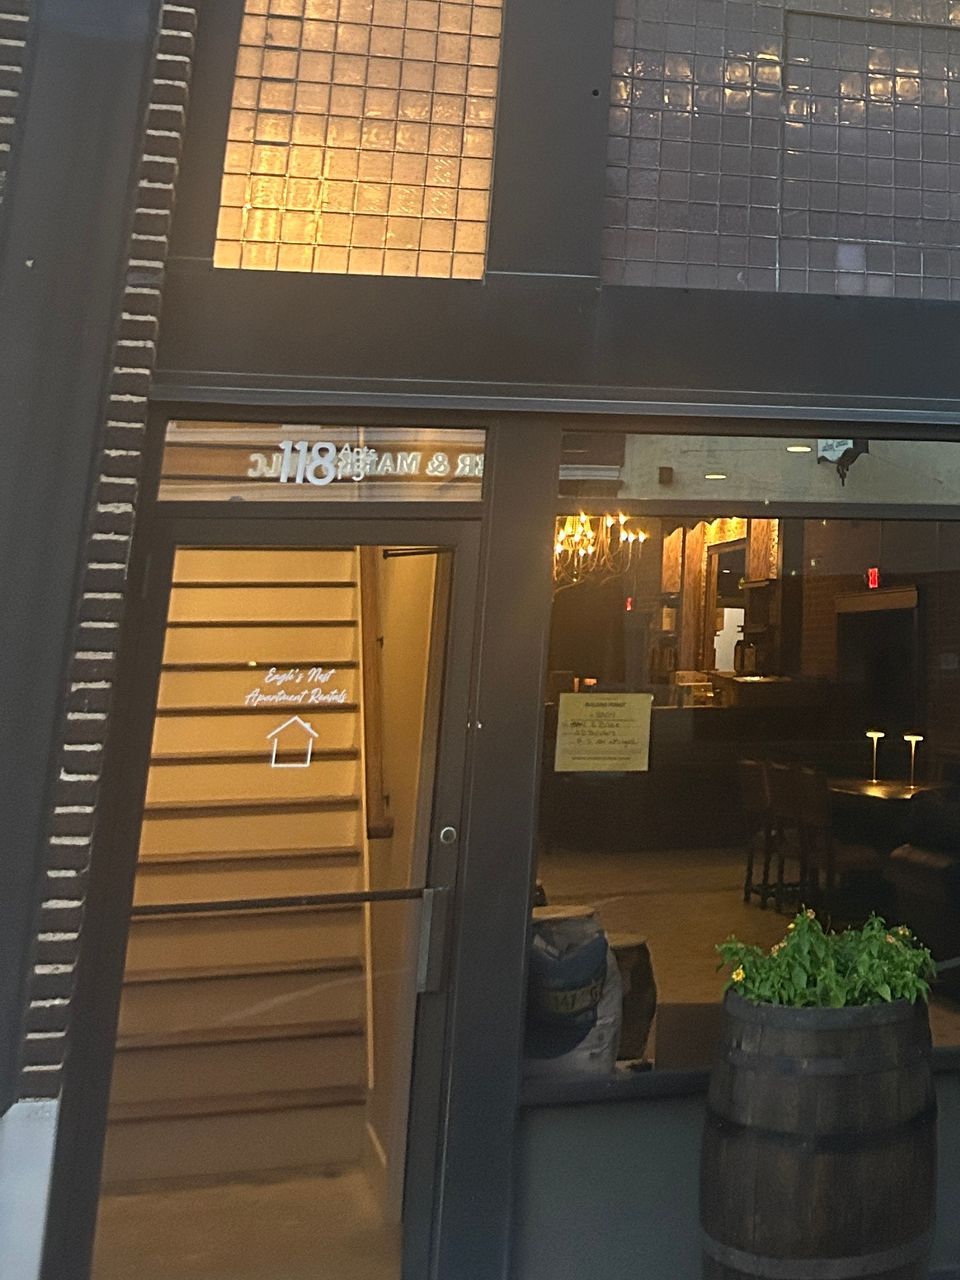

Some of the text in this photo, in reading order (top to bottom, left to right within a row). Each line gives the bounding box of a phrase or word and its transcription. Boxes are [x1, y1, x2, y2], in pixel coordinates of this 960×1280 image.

[278, 440, 337, 485] 118
[245, 688, 347, 705] Apartment Rentals
